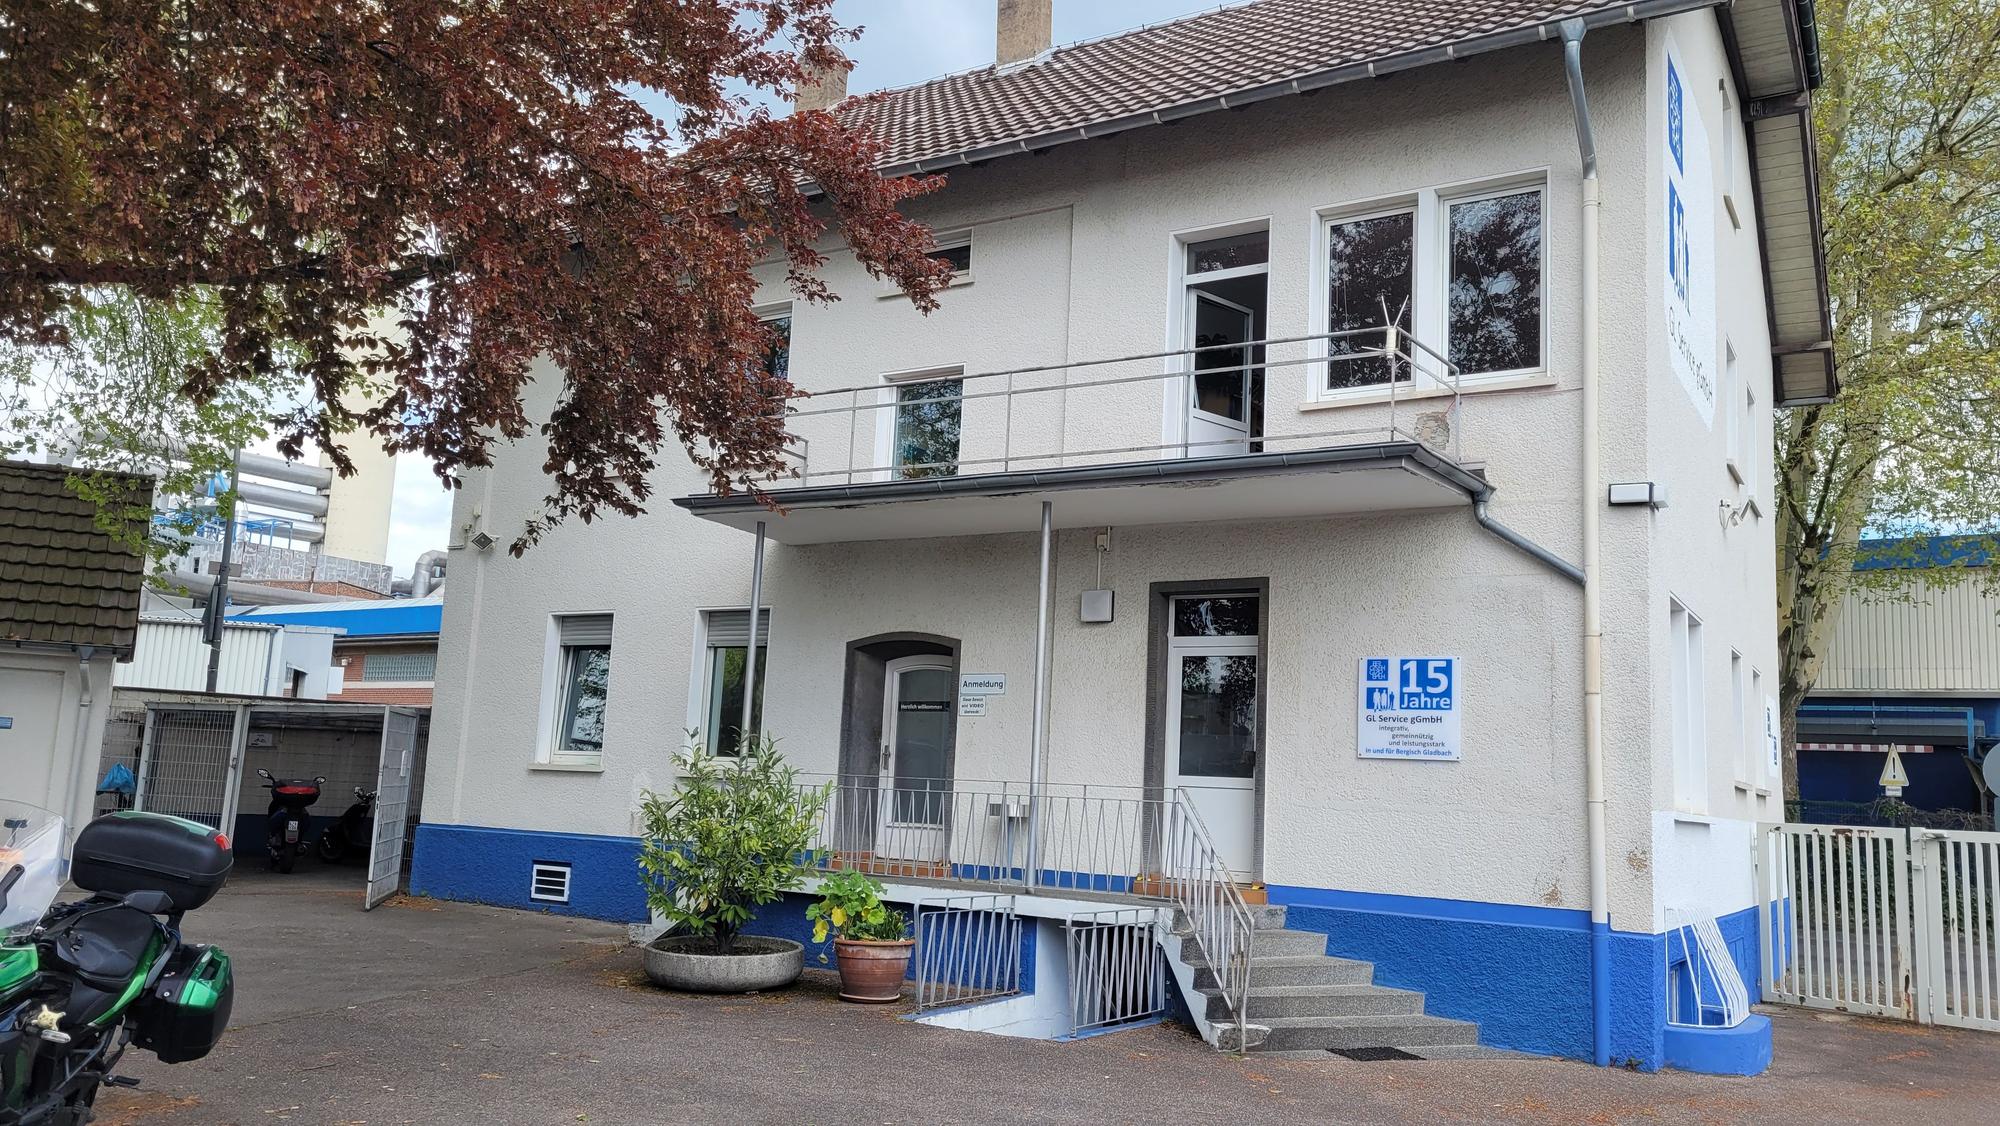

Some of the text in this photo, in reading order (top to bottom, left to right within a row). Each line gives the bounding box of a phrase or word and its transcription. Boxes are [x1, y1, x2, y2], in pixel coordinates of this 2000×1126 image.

[1402, 660, 1449, 694] 15
[962, 680, 1004, 689] Anmeldung
[1401, 693, 1451, 709] Jahre
[1366, 714, 1443, 725] GL Service gGmbH
[1391, 732, 1434, 741] gemeinnützig
[1401, 740, 1446, 748] leistungsstark
[1395, 748, 1422, 756] Bergisch
[1422, 749, 1452, 757] Gladbach
